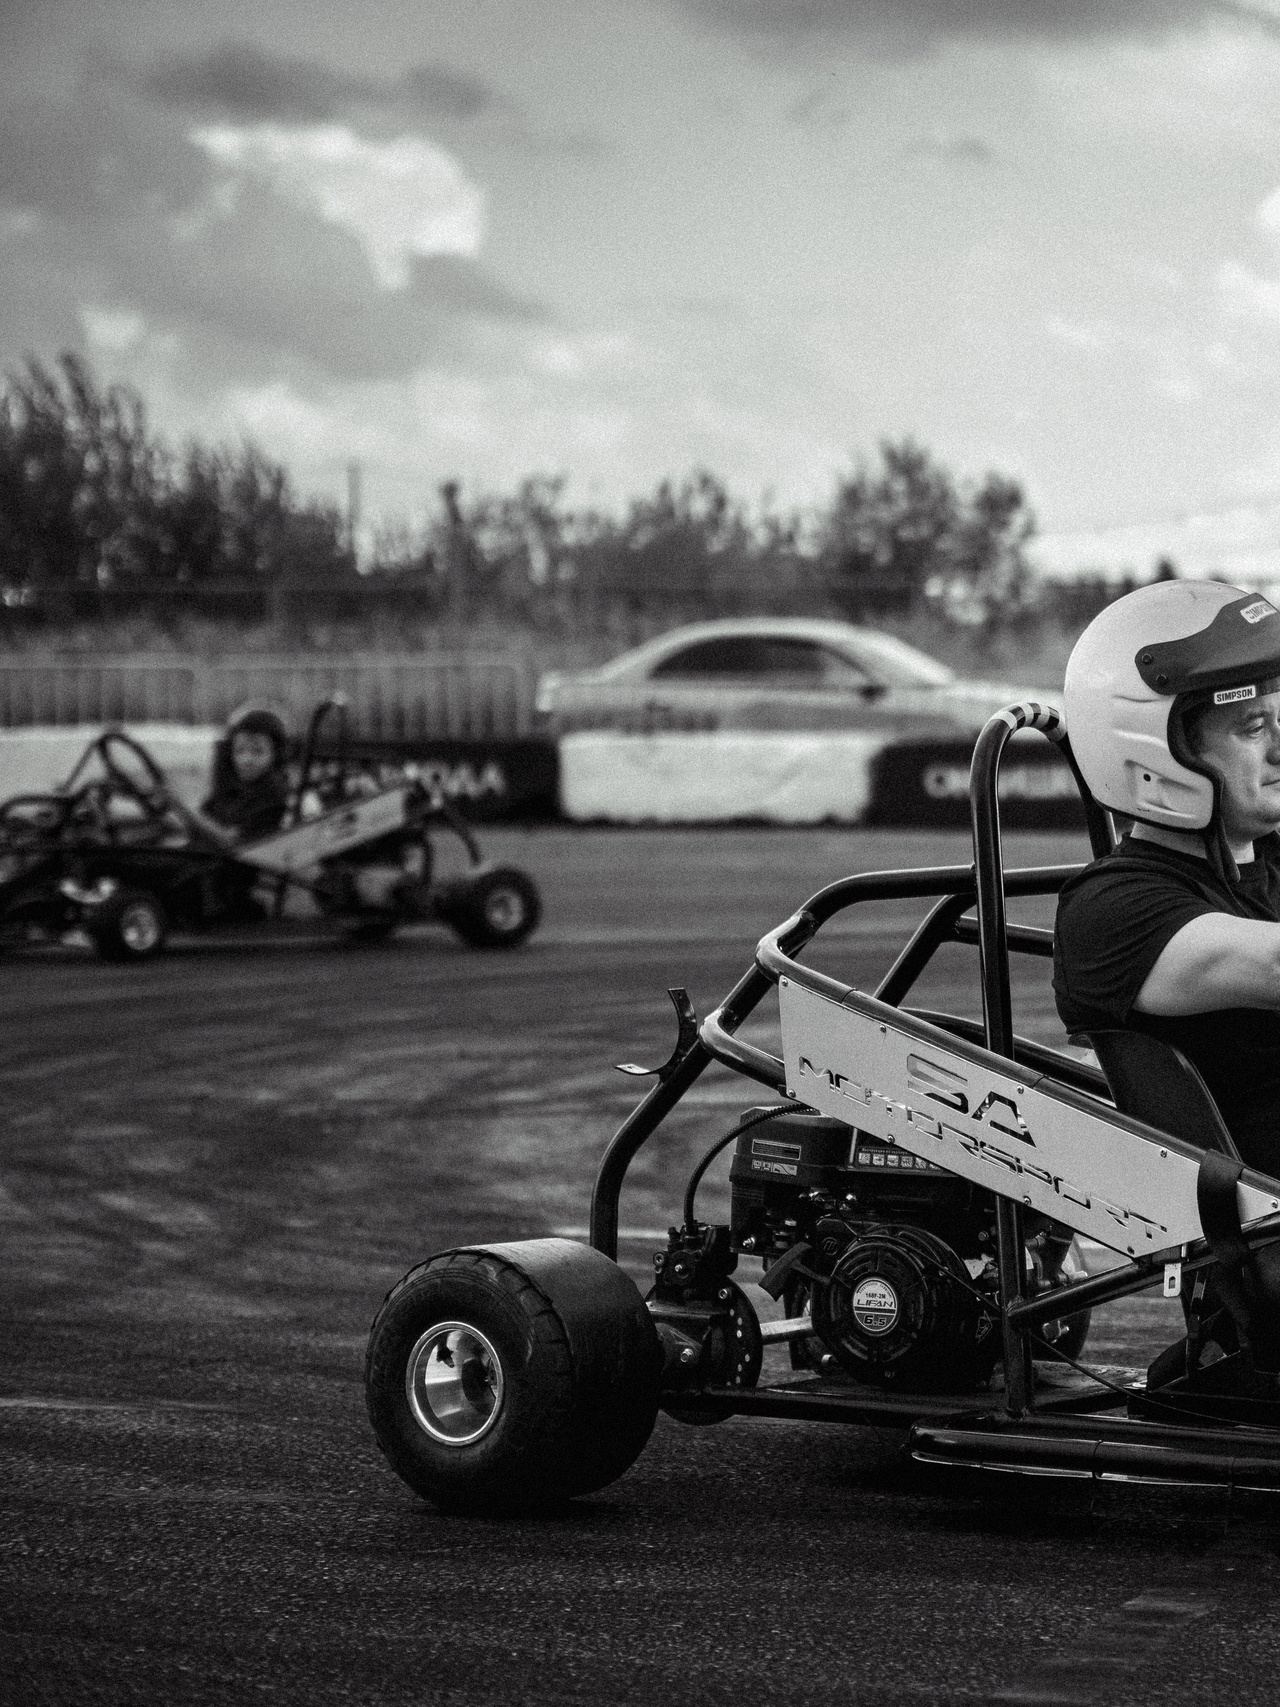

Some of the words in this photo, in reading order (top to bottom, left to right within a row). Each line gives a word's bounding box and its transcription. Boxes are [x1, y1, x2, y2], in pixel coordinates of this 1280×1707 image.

[1216, 688, 1253, 702] SIMPSON
[906, 1053, 1037, 1149] SA
[799, 1056, 1167, 1240] MOTORSPORT
[857, 1299, 893, 1307] LIFAN
[864, 1314, 886, 1326] 6.5
